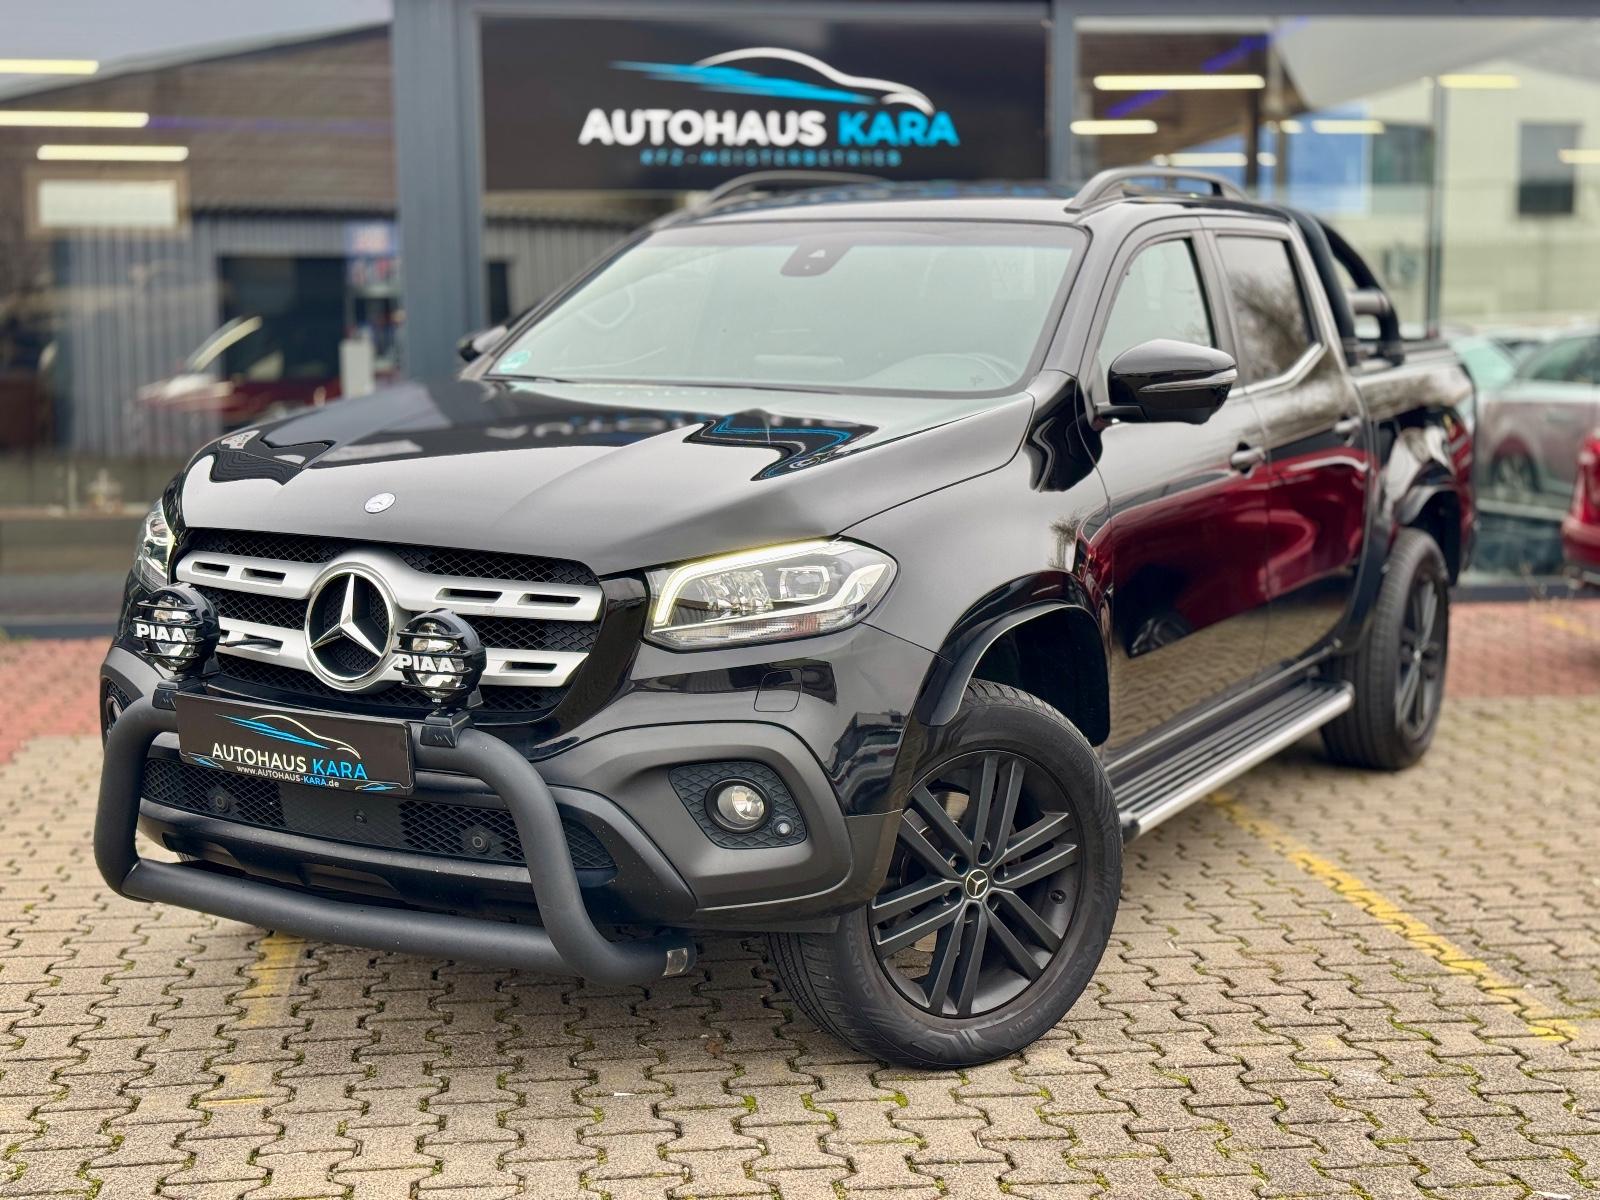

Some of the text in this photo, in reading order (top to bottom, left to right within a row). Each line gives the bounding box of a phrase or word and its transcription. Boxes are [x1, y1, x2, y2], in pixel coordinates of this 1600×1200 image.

[577, 108, 960, 146] AUTOHAUS KARA
[136, 622, 188, 643] PIAA
[397, 654, 456, 673] PIAA
[212, 742, 369, 780] AUTOHAUS KARA
[236, 765, 340, 788] www.AUTOHAUS-KARA.de
